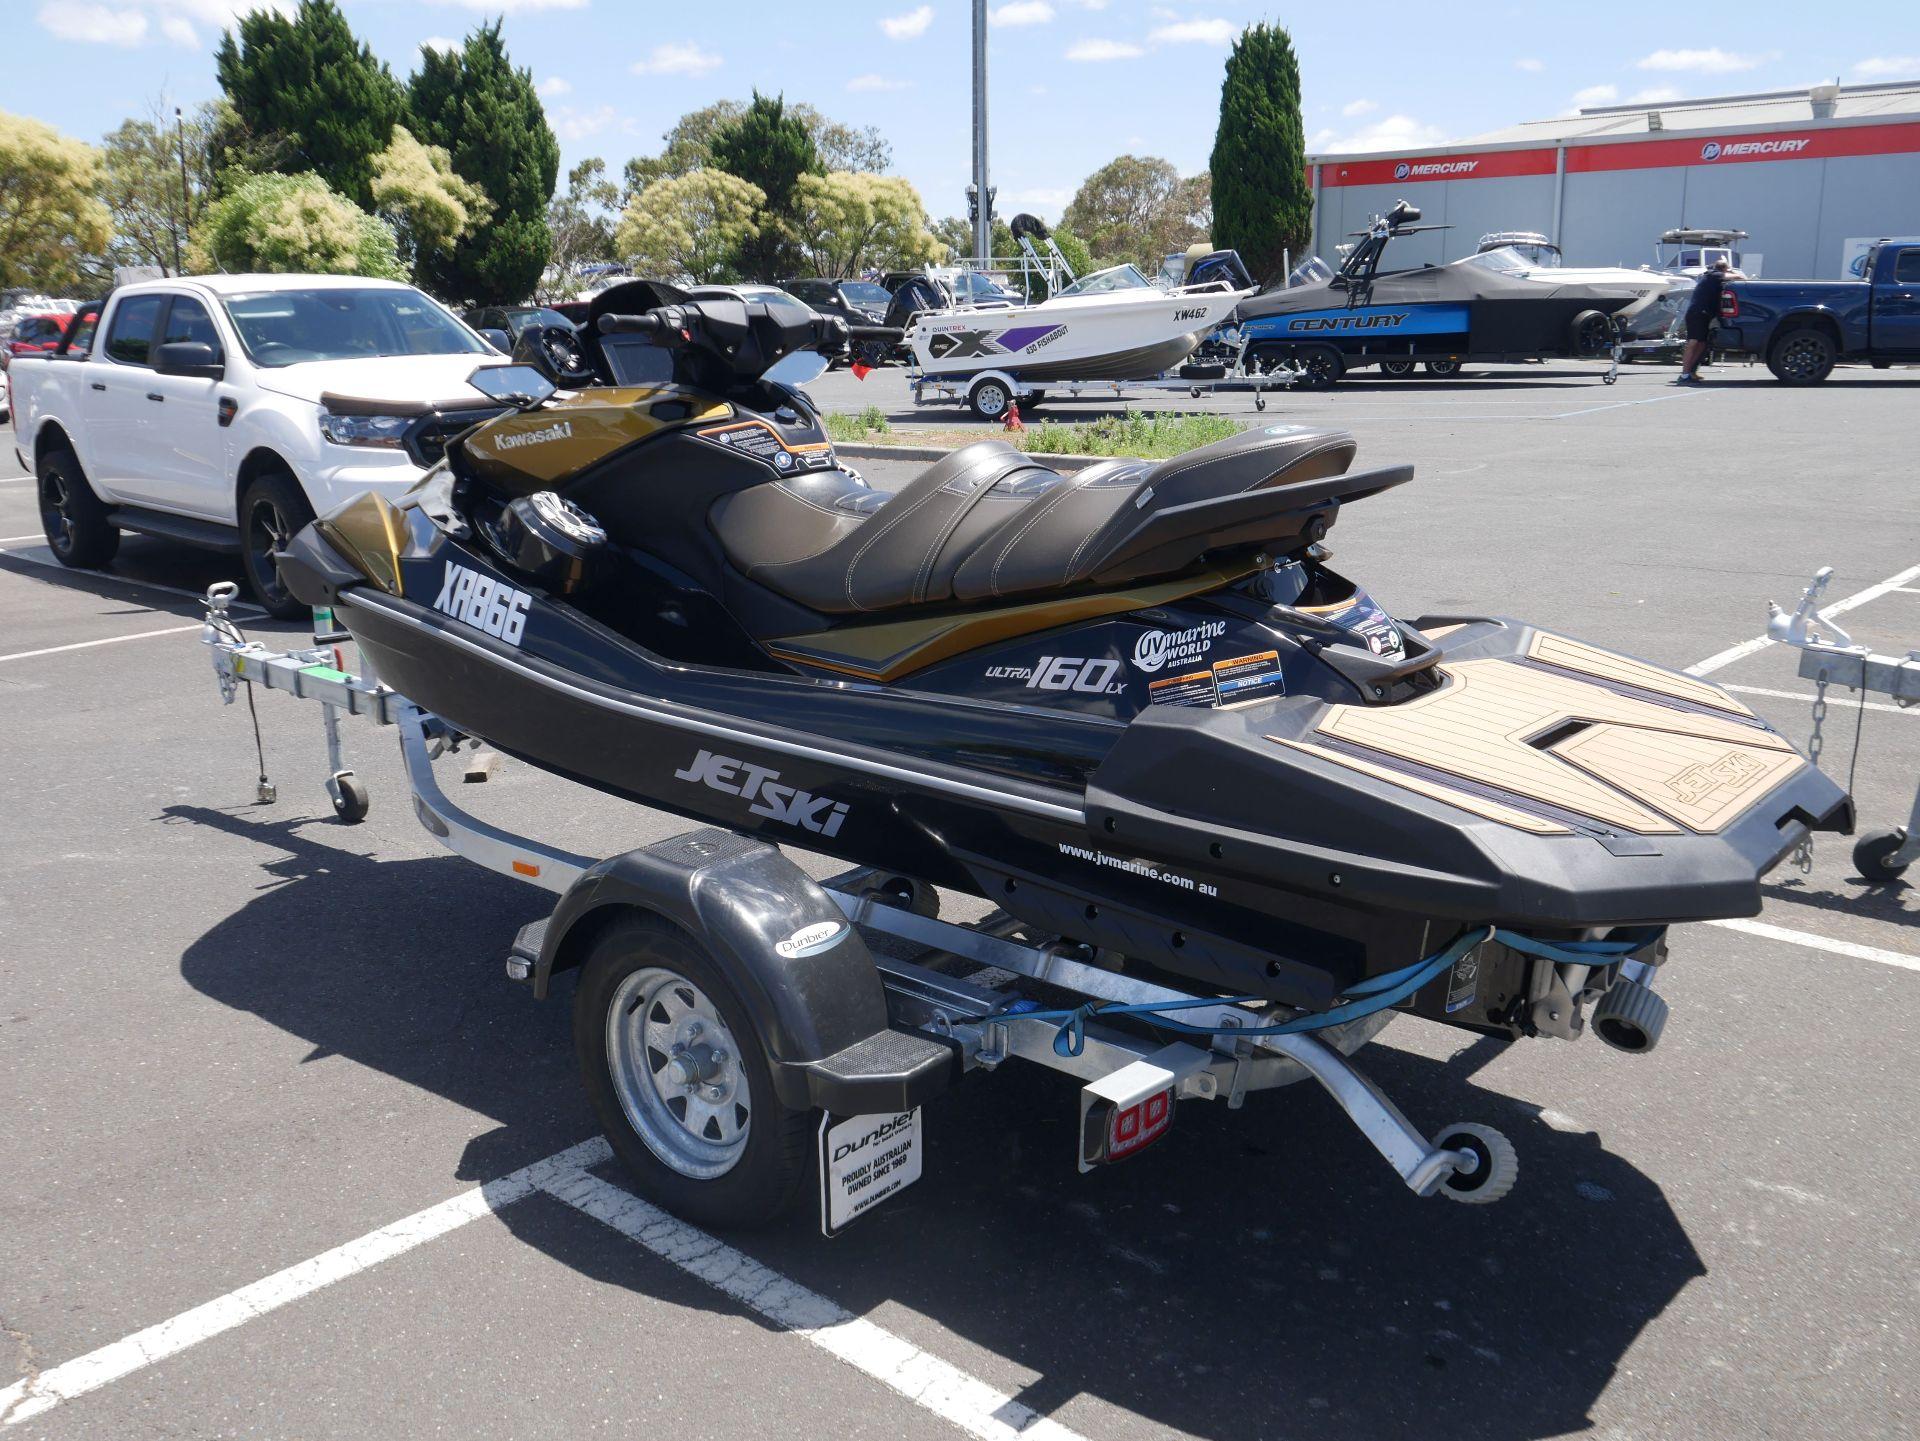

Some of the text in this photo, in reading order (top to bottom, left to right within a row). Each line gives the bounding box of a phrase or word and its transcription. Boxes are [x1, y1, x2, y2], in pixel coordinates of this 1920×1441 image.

[1722, 139, 1810, 156] MERCURY
[1411, 160, 1479, 176] MERCURY
[1173, 307, 1207, 321] XW462
[1288, 313, 1410, 332] CENTURY
[1025, 325, 1069, 355] 430 FISHABOUT
[494, 421, 573, 451] Kawasaki
[1164, 621, 1226, 647] marine
[1166, 640, 1211, 660] WORLD
[1167, 655, 1203, 669] AUSTRALIA
[1232, 654, 1264, 666] WARNING
[985, 656, 1128, 695] ULTRA 160 LX
[1237, 677, 1263, 688] NOTICE
[674, 749, 781, 801] JET
[1669, 764, 1718, 803] JET
[1058, 842, 1195, 890] www.jvmarine.com
[782, 929, 829, 952] Dunbier
[833, 1107, 918, 1163] Dunbier
[842, 1139, 912, 1187] PROUDLY AUSTRALIAN
[847, 1154, 907, 1195] OWNED SINCE 1969
[854, 1179, 902, 1212] WWW.DUNBIER.COM
